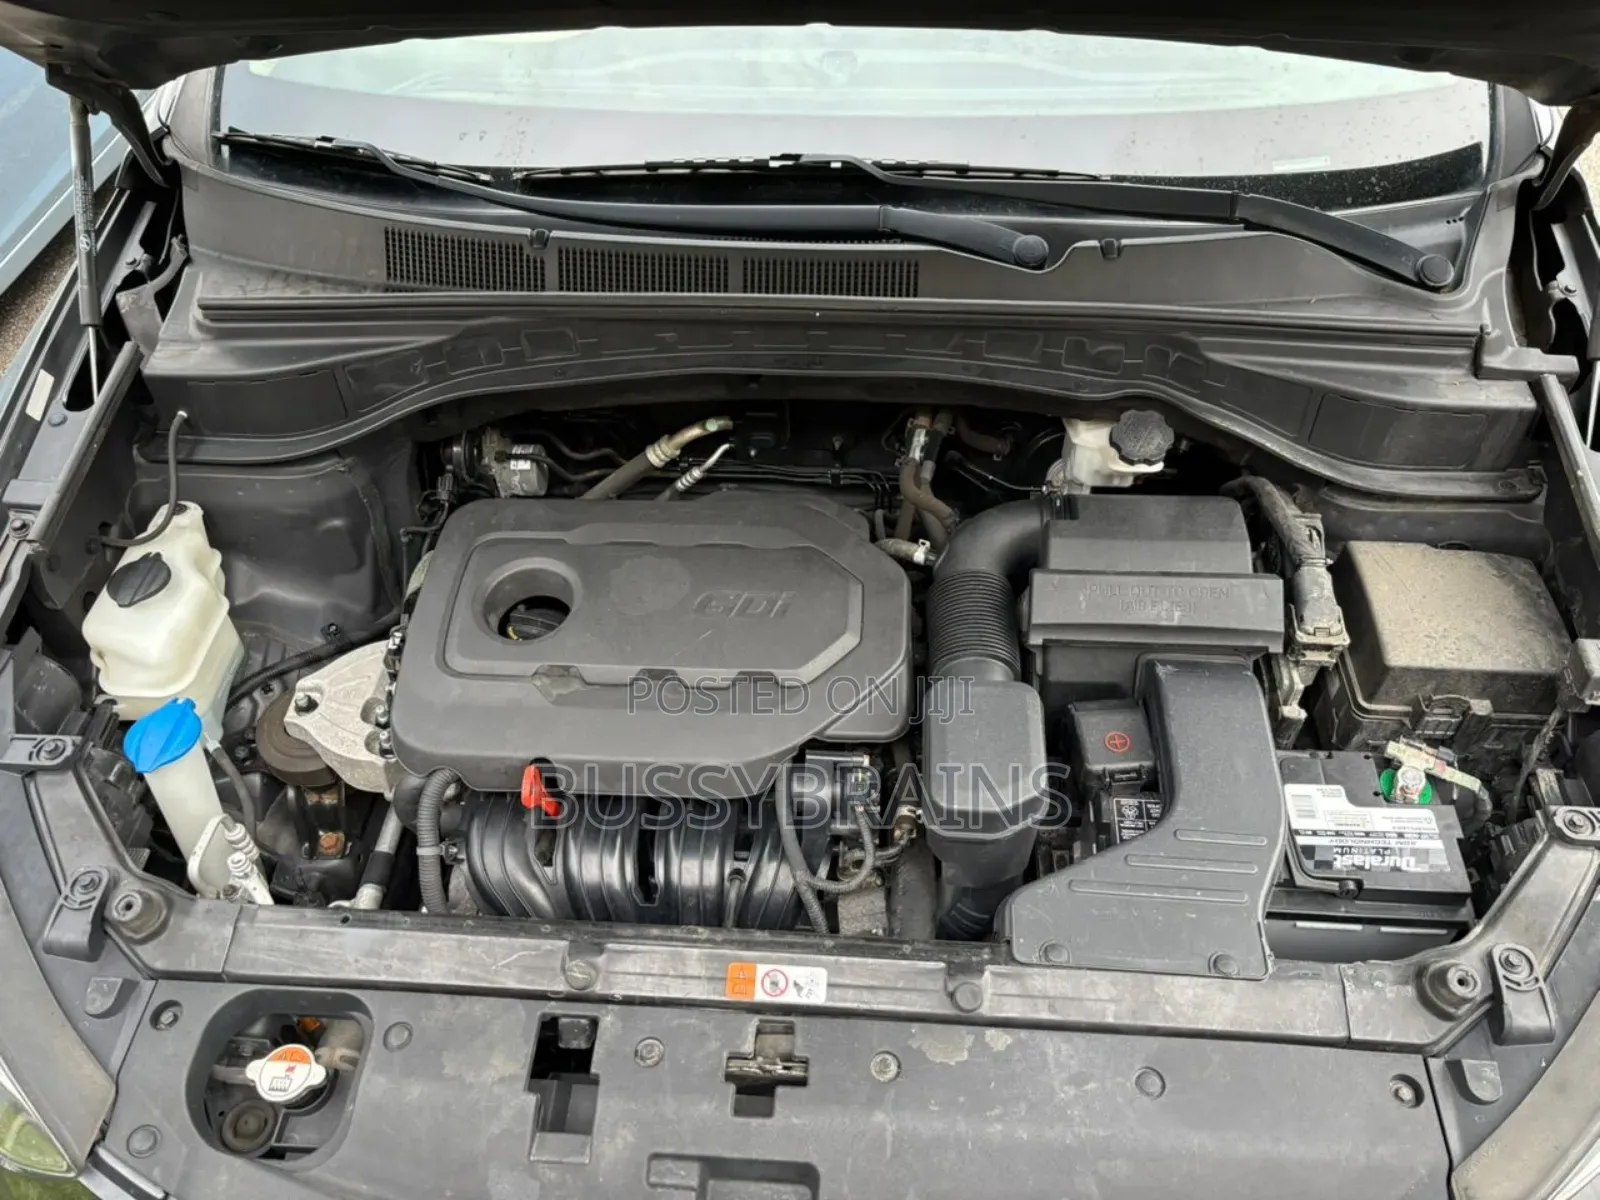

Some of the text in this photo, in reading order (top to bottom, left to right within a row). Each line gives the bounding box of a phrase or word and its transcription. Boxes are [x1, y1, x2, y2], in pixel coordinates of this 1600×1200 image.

[1129, 584, 1161, 598] OUT
[1333, 847, 1391, 855] PLATINUM
[1333, 854, 1416, 870] Duralast
